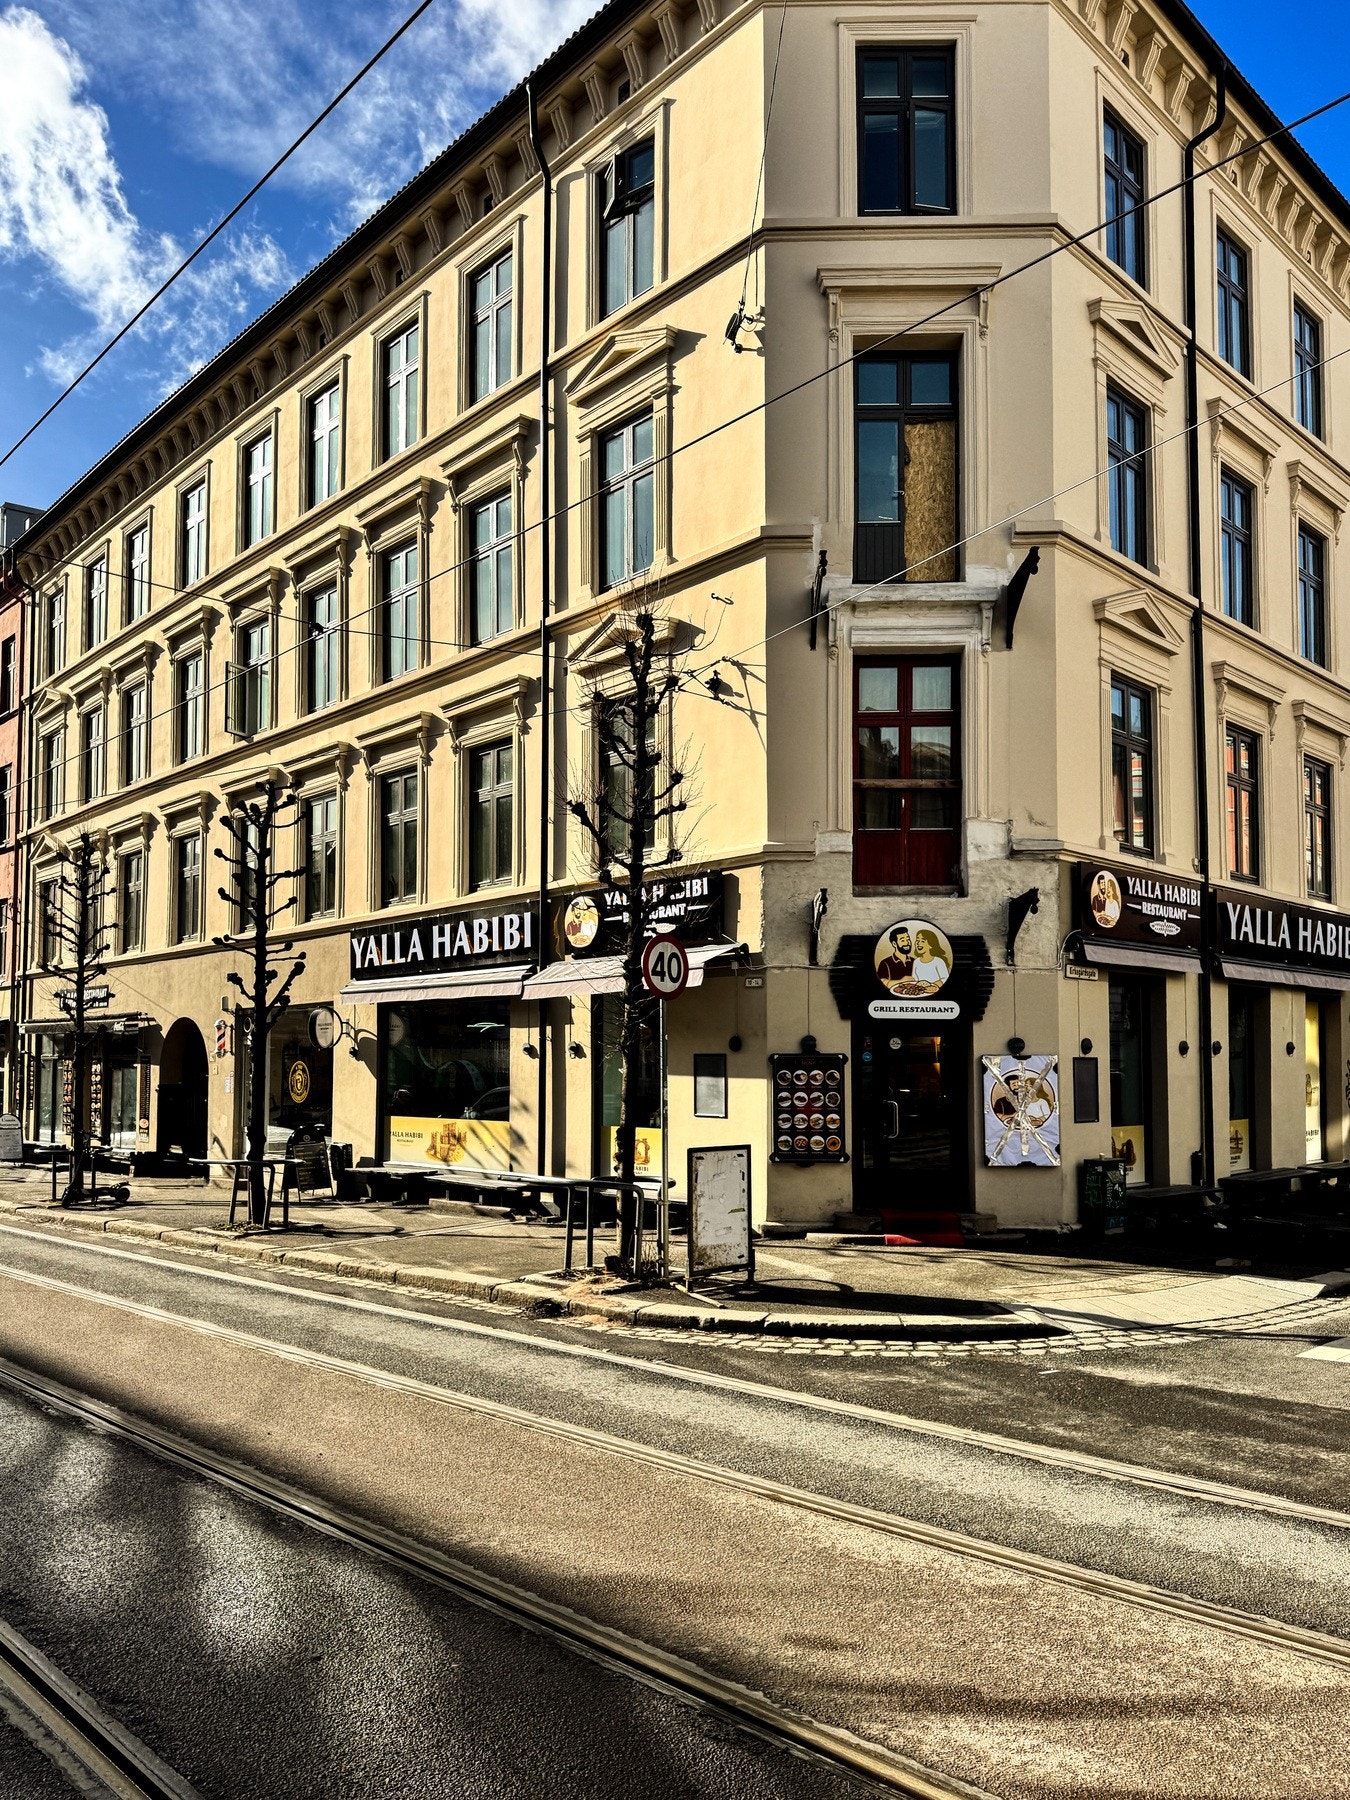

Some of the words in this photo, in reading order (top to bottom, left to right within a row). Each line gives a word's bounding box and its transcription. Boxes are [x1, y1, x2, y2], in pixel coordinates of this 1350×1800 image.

[1126, 876, 1162, 900] YALLA
[1164, 884, 1201, 907] HABIBI
[1142, 901, 1187, 921] RESTAURANT
[1226, 901, 1291, 949] YALLA
[351, 928, 424, 969] YALLA
[432, 911, 532, 959] HABIBI
[650, 951, 682, 984] 40
[873, 1001, 898, 1013] GRILL
[899, 1001, 955, 1014] RESTAURANT
